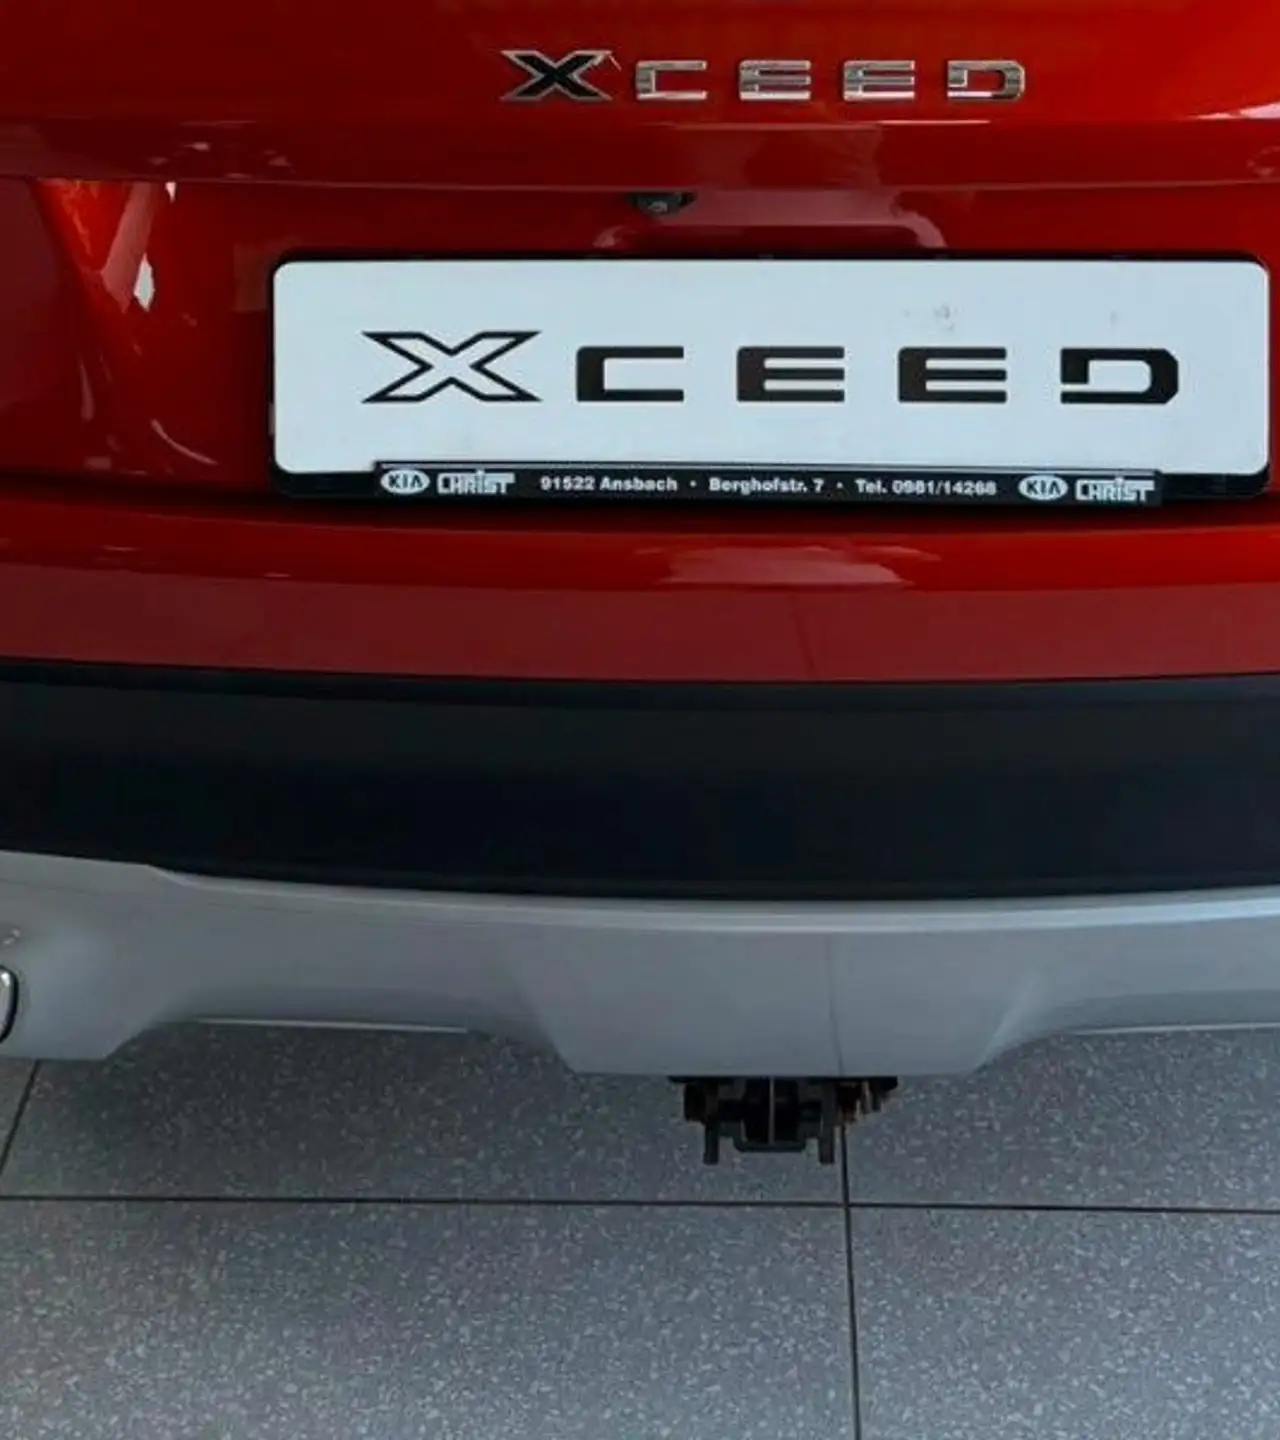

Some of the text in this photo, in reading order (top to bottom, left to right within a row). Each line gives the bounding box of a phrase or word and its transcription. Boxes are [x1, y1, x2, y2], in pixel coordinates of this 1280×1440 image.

[500, 48, 1026, 102] XCEED
[361, 330, 1180, 405] XCEED
[384, 471, 426, 492] KIA
[540, 475, 595, 491] 91522
[599, 475, 677, 491] Ansbach
[708, 477, 808, 495] Berghofstr.
[813, 478, 824, 492] 7
[854, 478, 888, 494] Tel.
[1023, 476, 1065, 499] KIA
